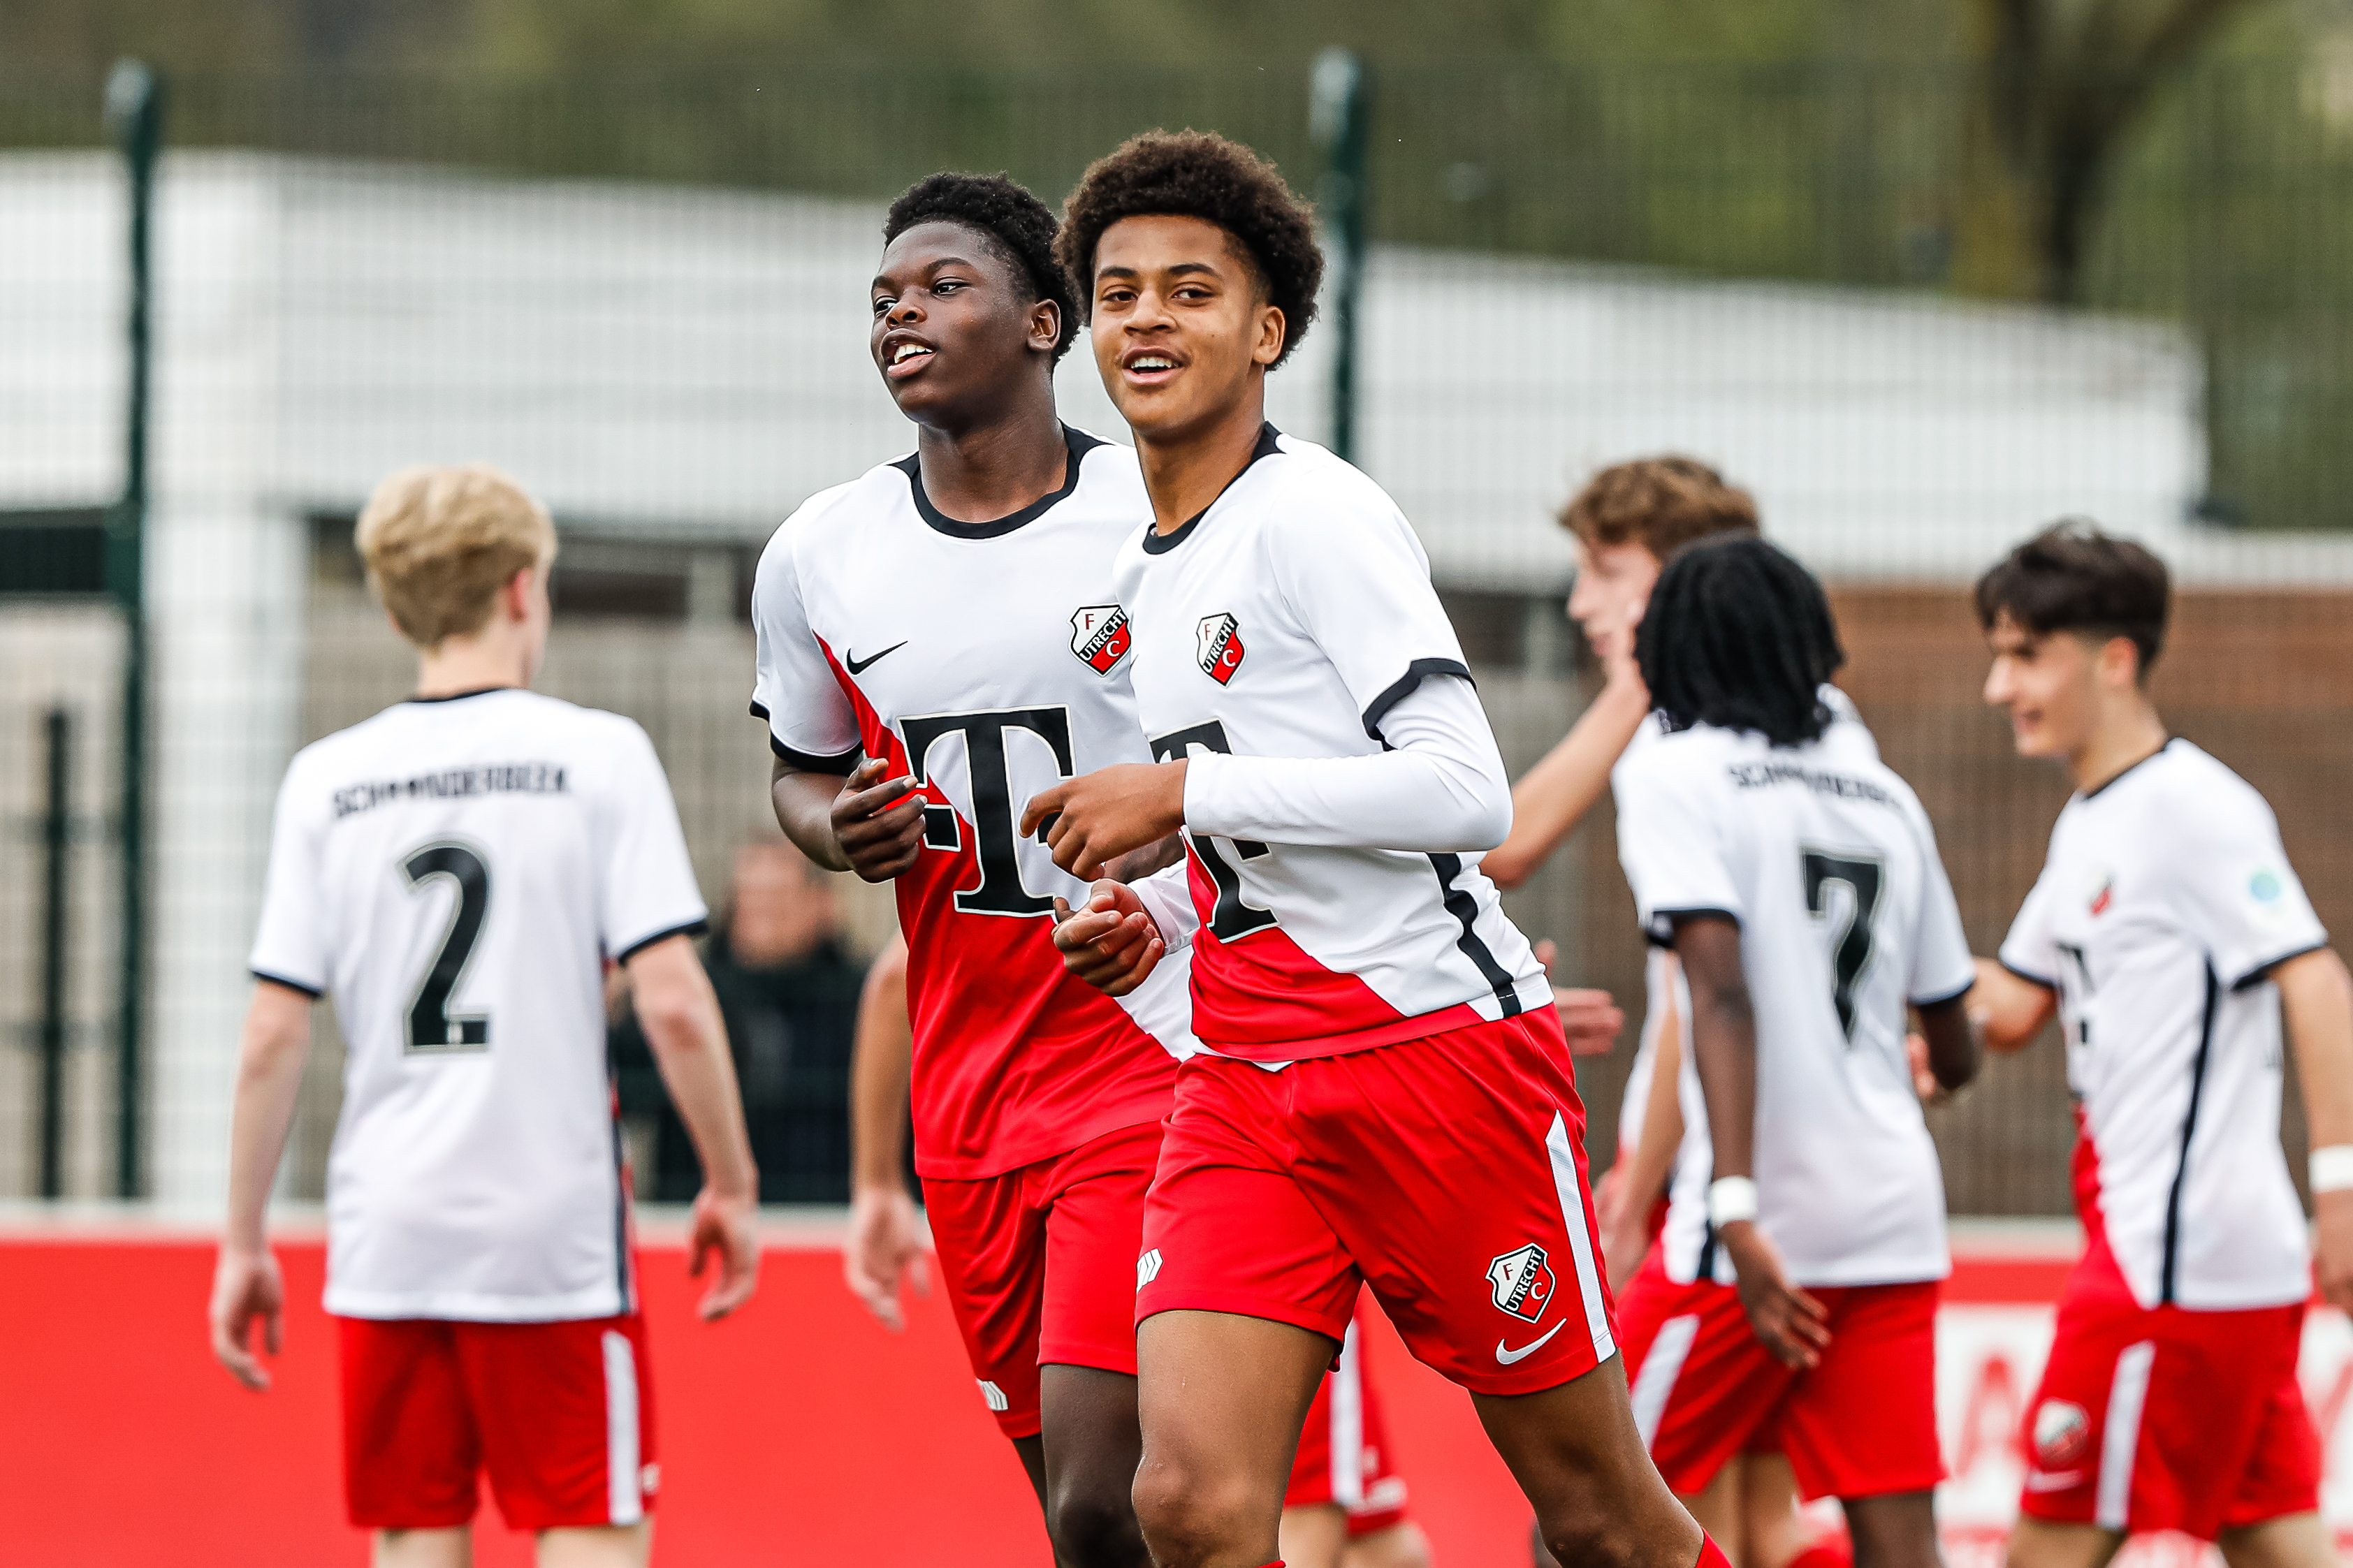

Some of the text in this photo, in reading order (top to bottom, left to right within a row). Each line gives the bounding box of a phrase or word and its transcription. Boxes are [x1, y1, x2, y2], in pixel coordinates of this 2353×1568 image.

[1079, 609, 1127, 661] UTRECHT
[1085, 613, 1095, 630] F
[1204, 623, 1211, 641] F
[1105, 640, 1121, 657] C
[1202, 616, 1235, 674] UTRECHT
[1221, 649, 1237, 667] C
[896, 703, 1077, 918] T
[397, 840, 491, 1055] 2
[1800, 846, 1888, 1045] 7
[1502, 1262, 1514, 1281] F
[1506, 1250, 1542, 1312] UTRECHT
[1529, 1282, 1546, 1300] C
